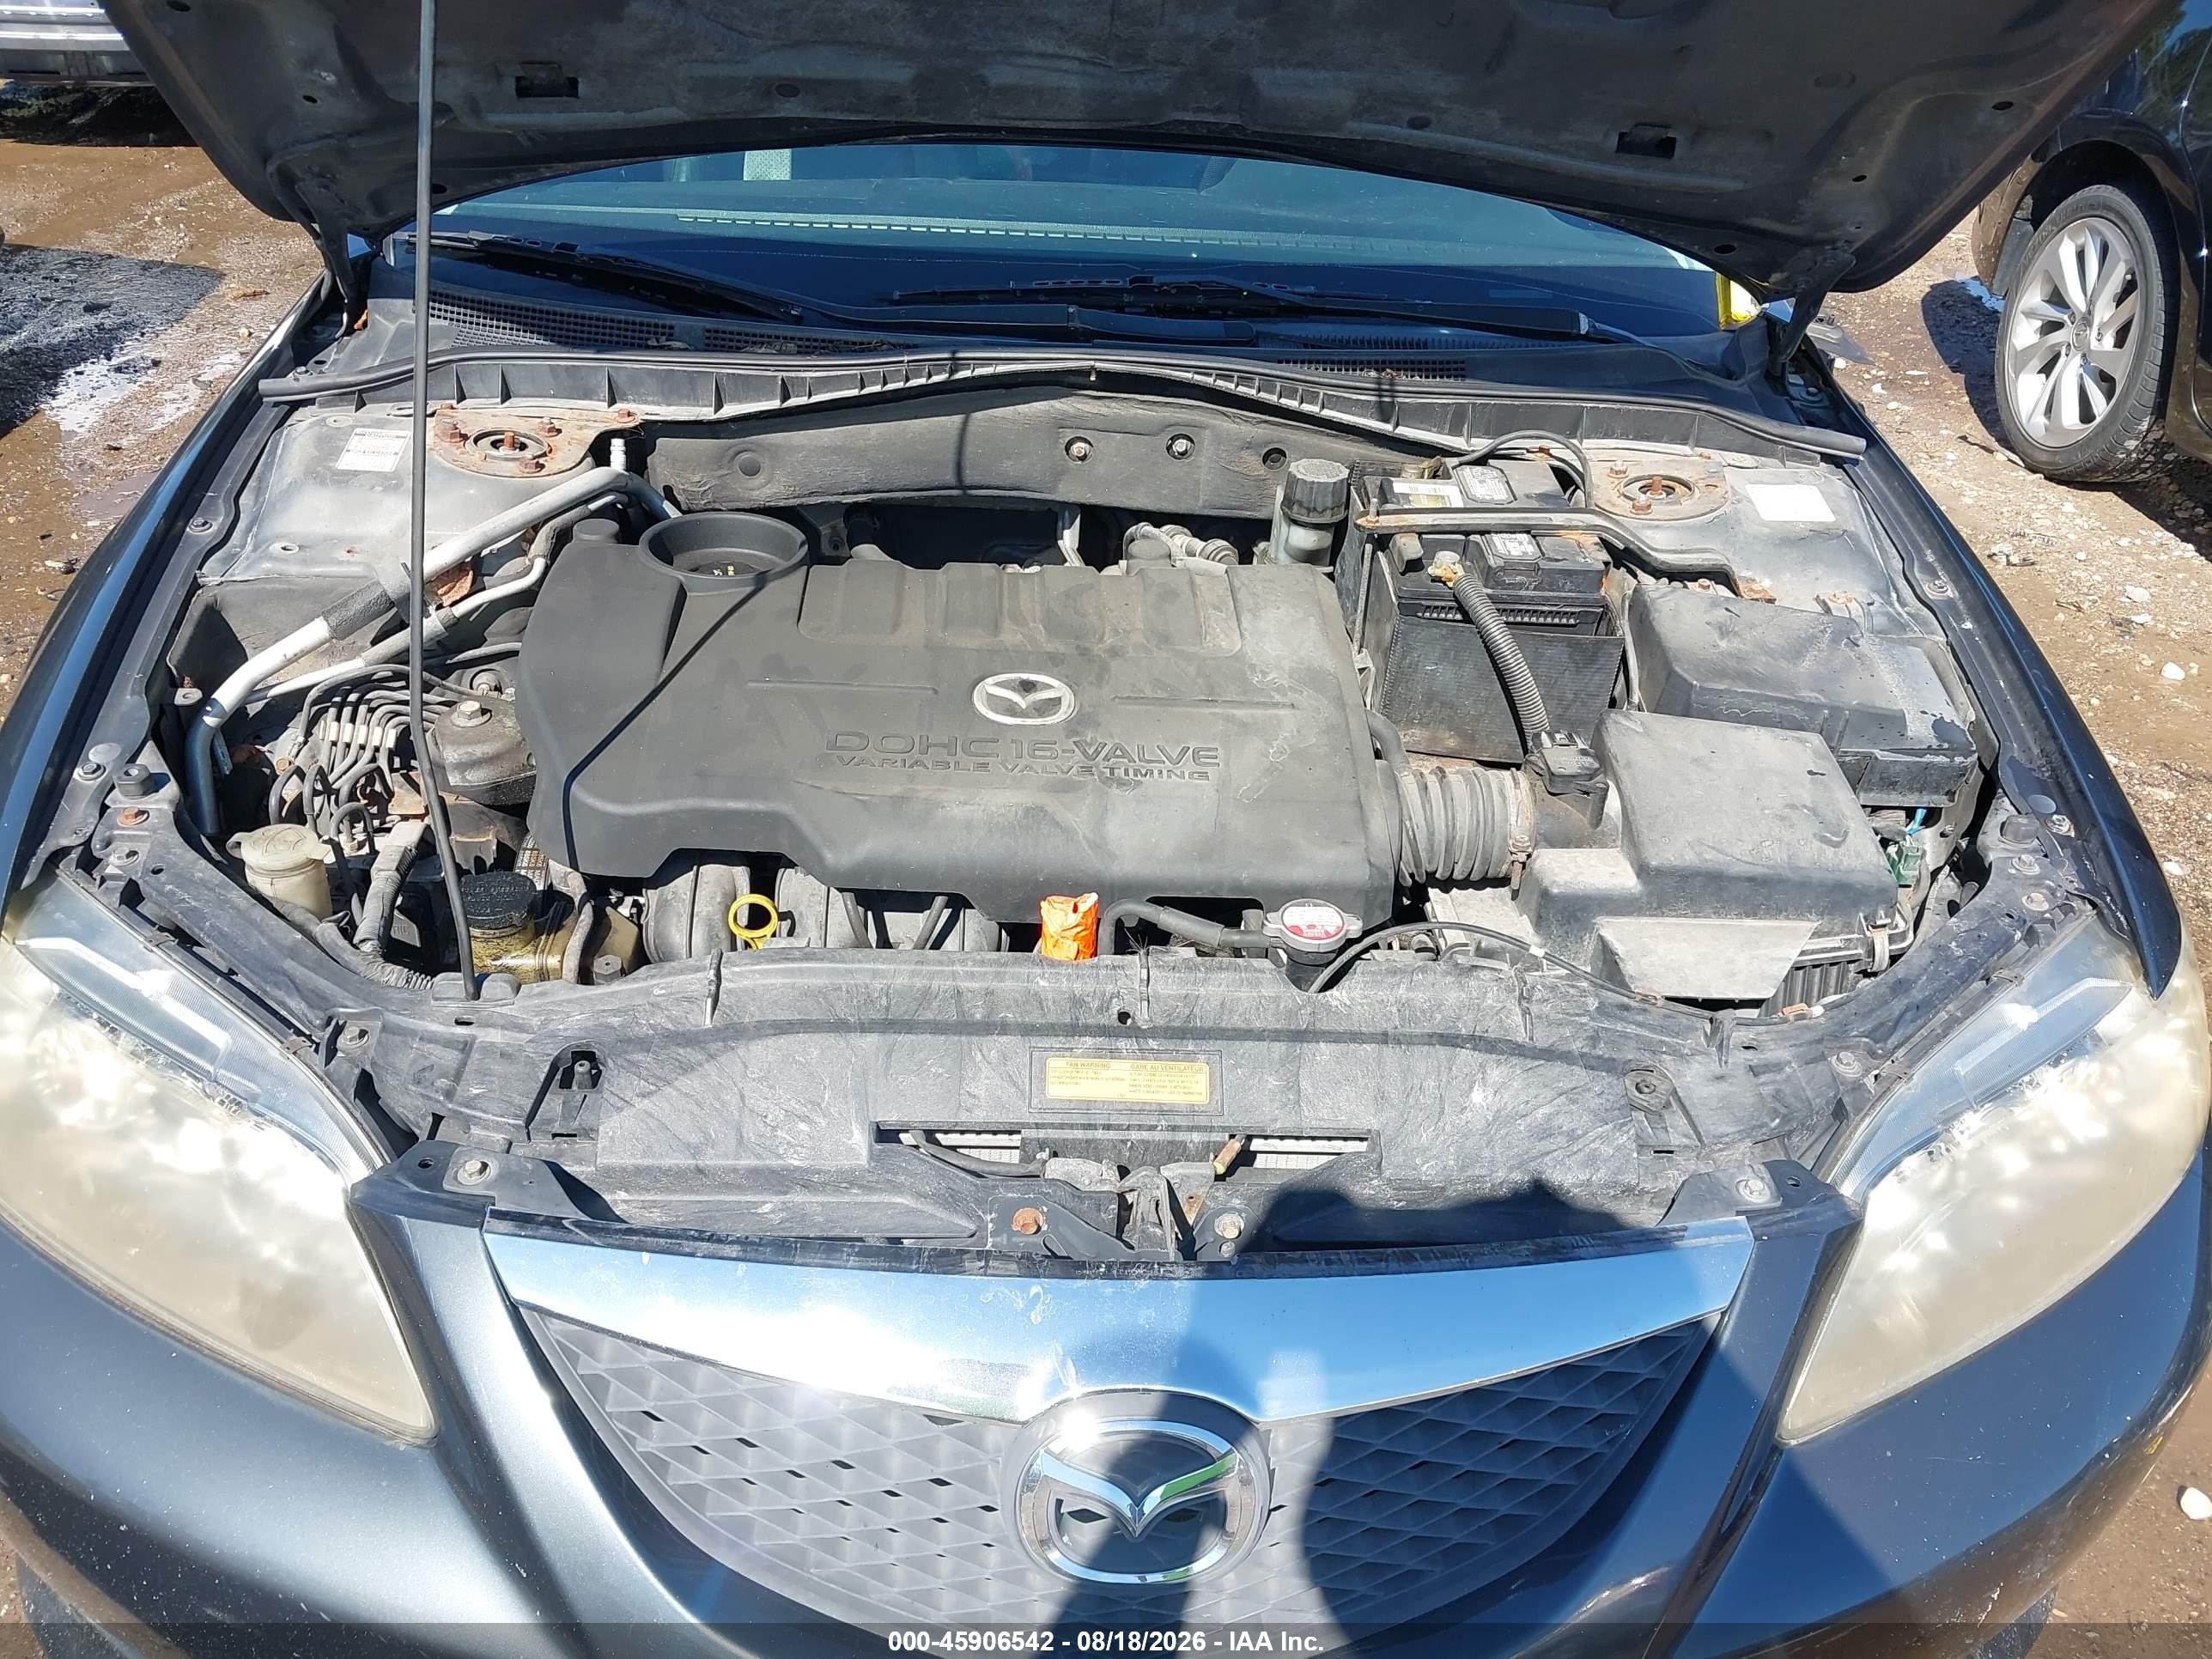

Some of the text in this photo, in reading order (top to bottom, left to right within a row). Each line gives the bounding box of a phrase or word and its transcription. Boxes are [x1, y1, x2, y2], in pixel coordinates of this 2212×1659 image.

[826, 732, 1220, 768] DOHC 16-VALVE
[836, 755, 1210, 782] VARIABLE VALVE TIMING
